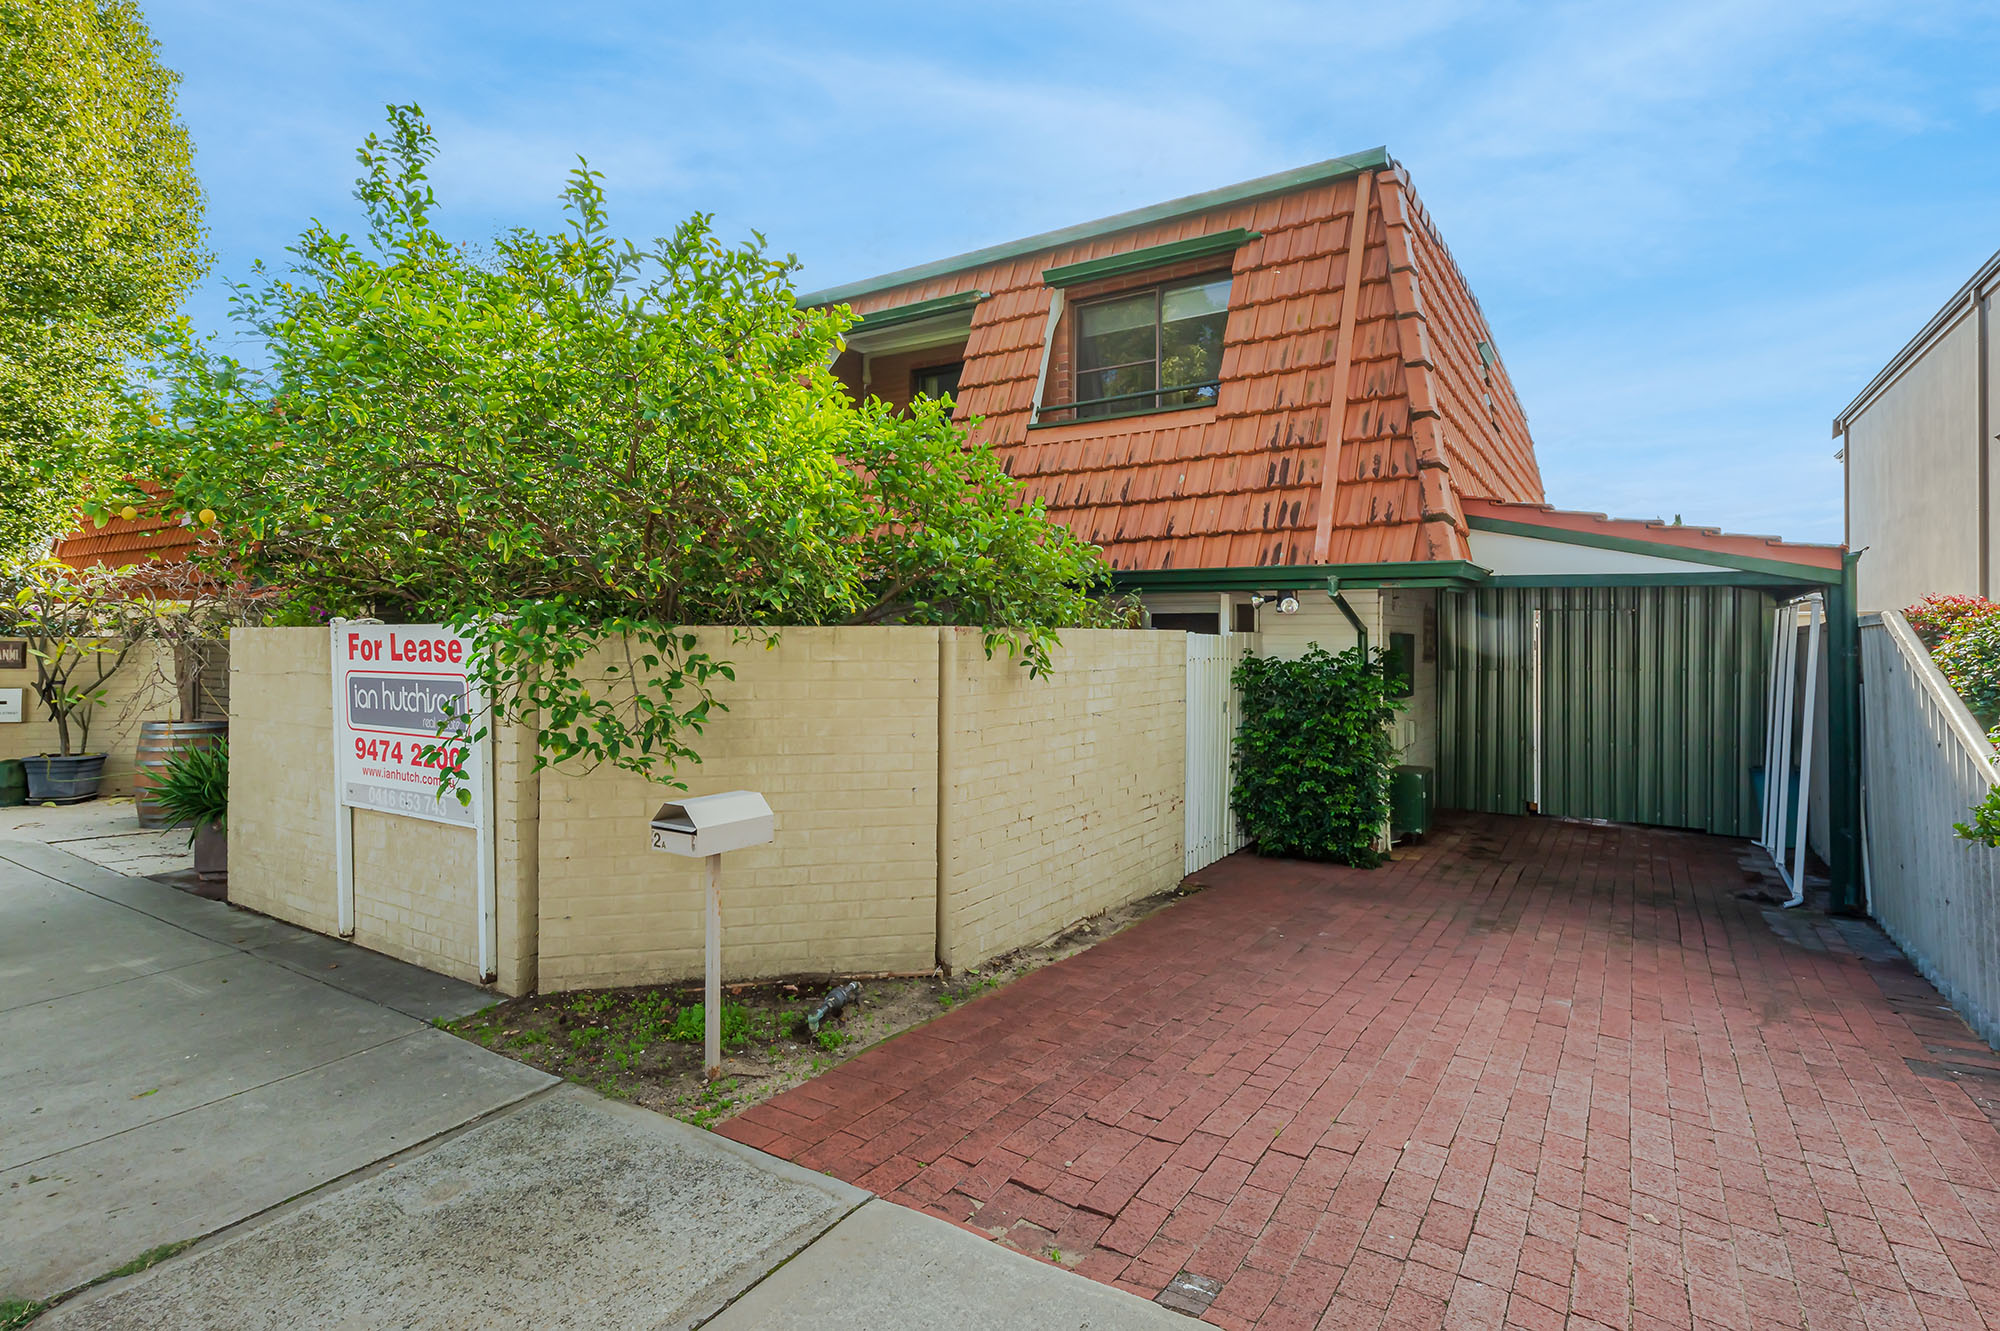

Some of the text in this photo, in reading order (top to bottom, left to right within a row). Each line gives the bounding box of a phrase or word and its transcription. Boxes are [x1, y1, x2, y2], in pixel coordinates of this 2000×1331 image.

[348, 632, 463, 663] For Lease
[353, 680, 460, 715] ian hutchison
[355, 737, 403, 764] 9474
[362, 766, 455, 788] www.ianhutch.comu
[368, 786, 447, 817] 0416 653 743
